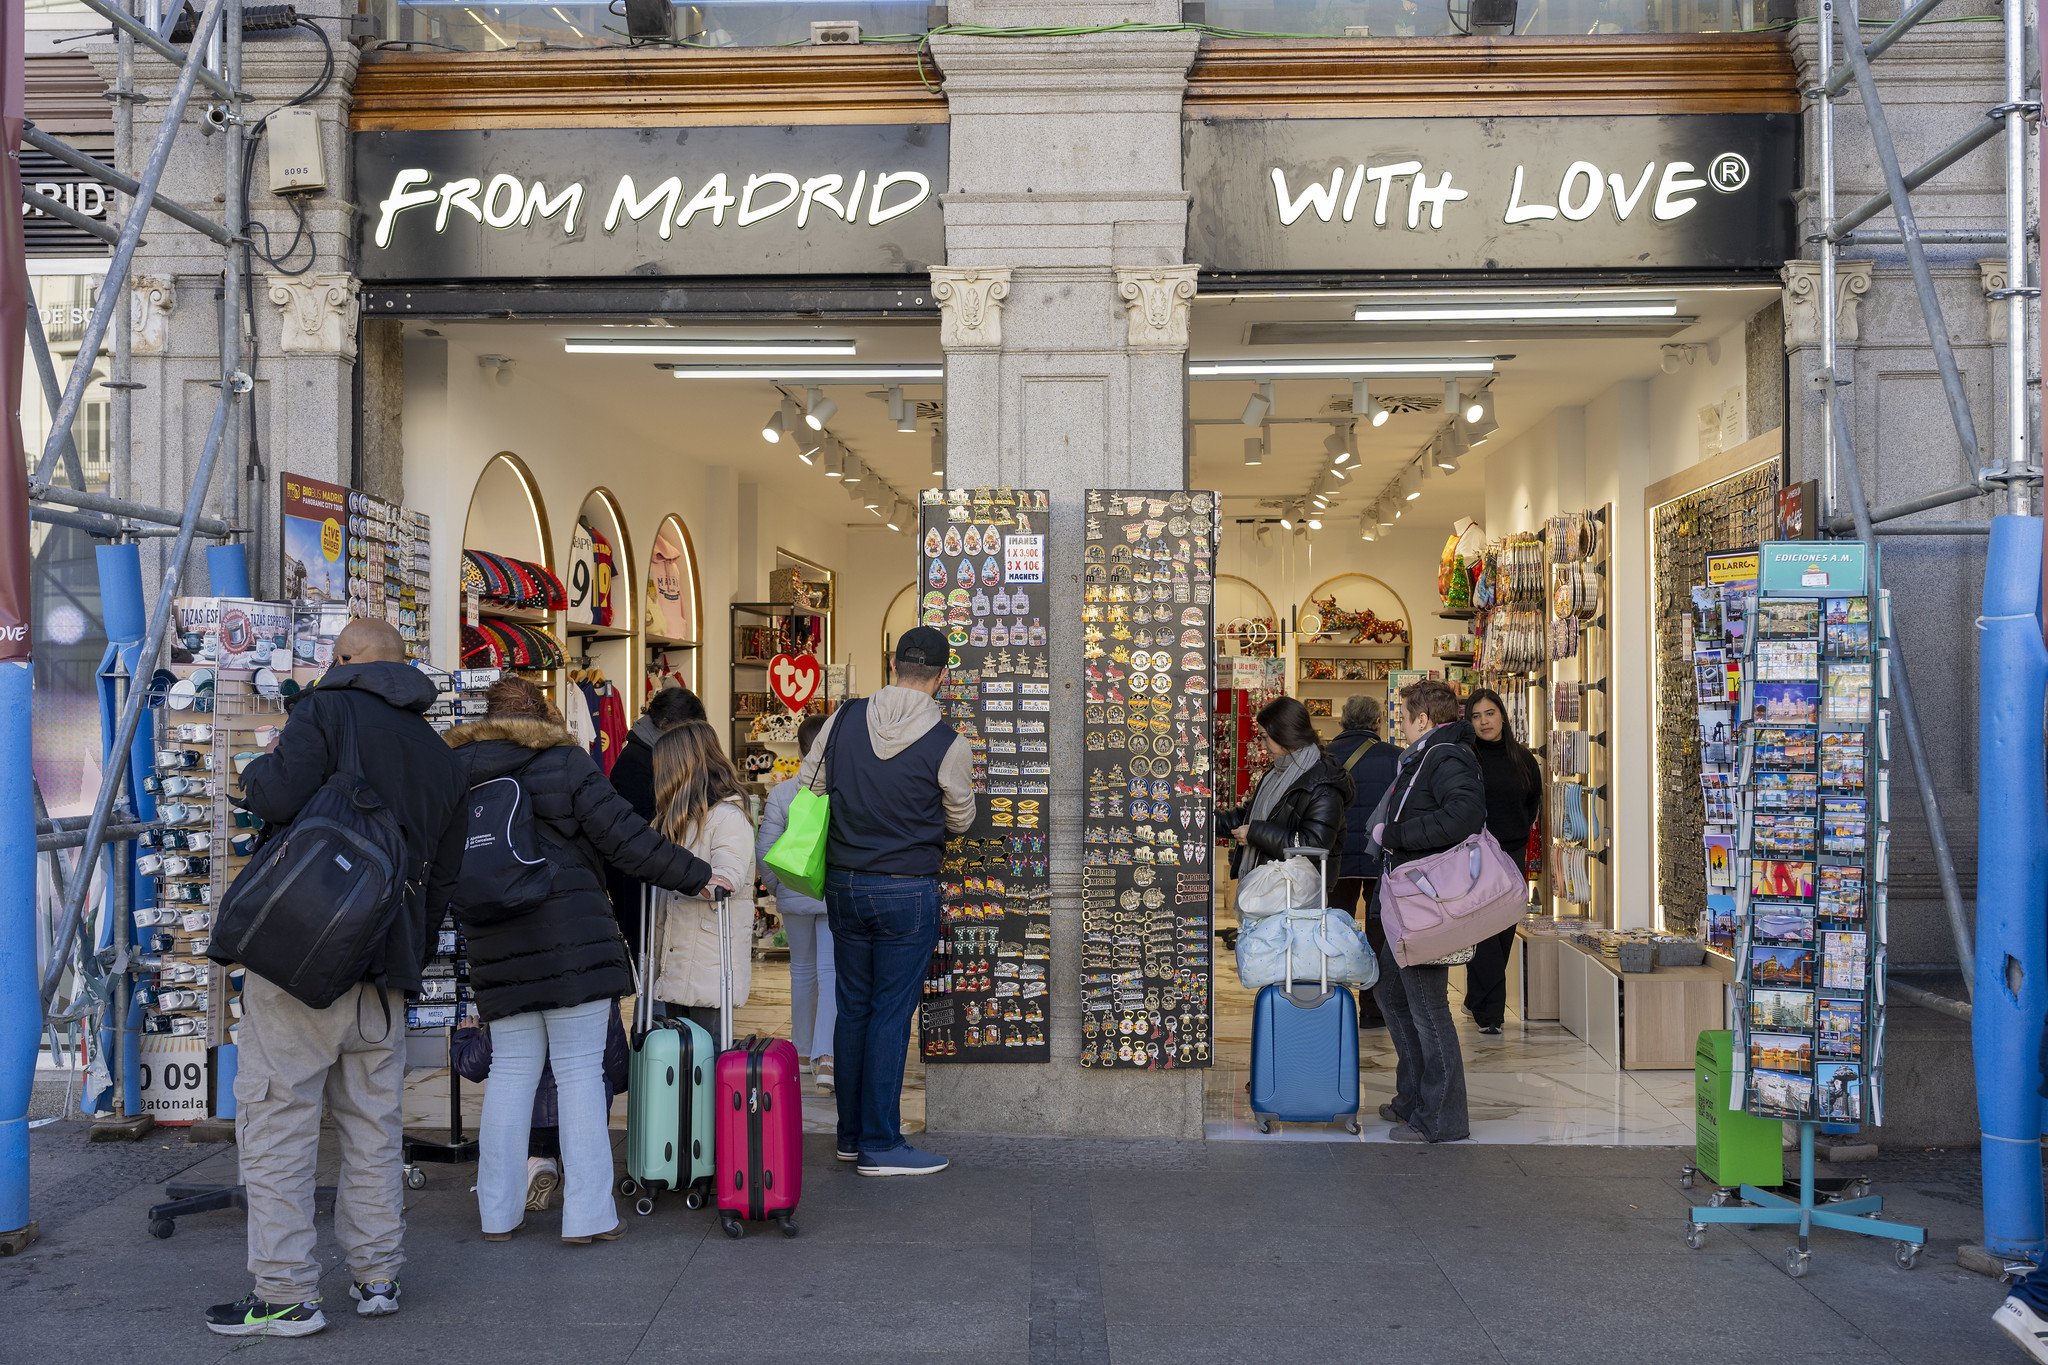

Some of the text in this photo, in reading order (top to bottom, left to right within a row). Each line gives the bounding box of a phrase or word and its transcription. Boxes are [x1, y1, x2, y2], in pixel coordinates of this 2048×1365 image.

[284, 167, 309, 176] 8095
[22, 183, 106, 216] RID
[374, 168, 585, 249] FROM
[604, 169, 932, 241] MADRID
[1270, 160, 1469, 230] WITH
[322, 490, 344, 504] MADRID
[302, 497, 344, 512] PANORAMIC CITY TOUR
[1008, 537, 1038, 545] IMANES
[1020, 548, 1039, 559] 3,90€
[1775, 554, 1853, 562] EDICIONES A.M.
[1007, 560, 1013, 571] 3
[1024, 560, 1040, 571] 10€
[570, 559, 590, 607] 9
[1008, 573, 1039, 581] MAGNETS
[181, 608, 203, 627] TAZAS
[250, 613, 266, 627] TAZAS
[474, 674, 491, 683] CARLOS
[773, 657, 815, 702] ty
[141, 1097, 209, 1112] @atonala
